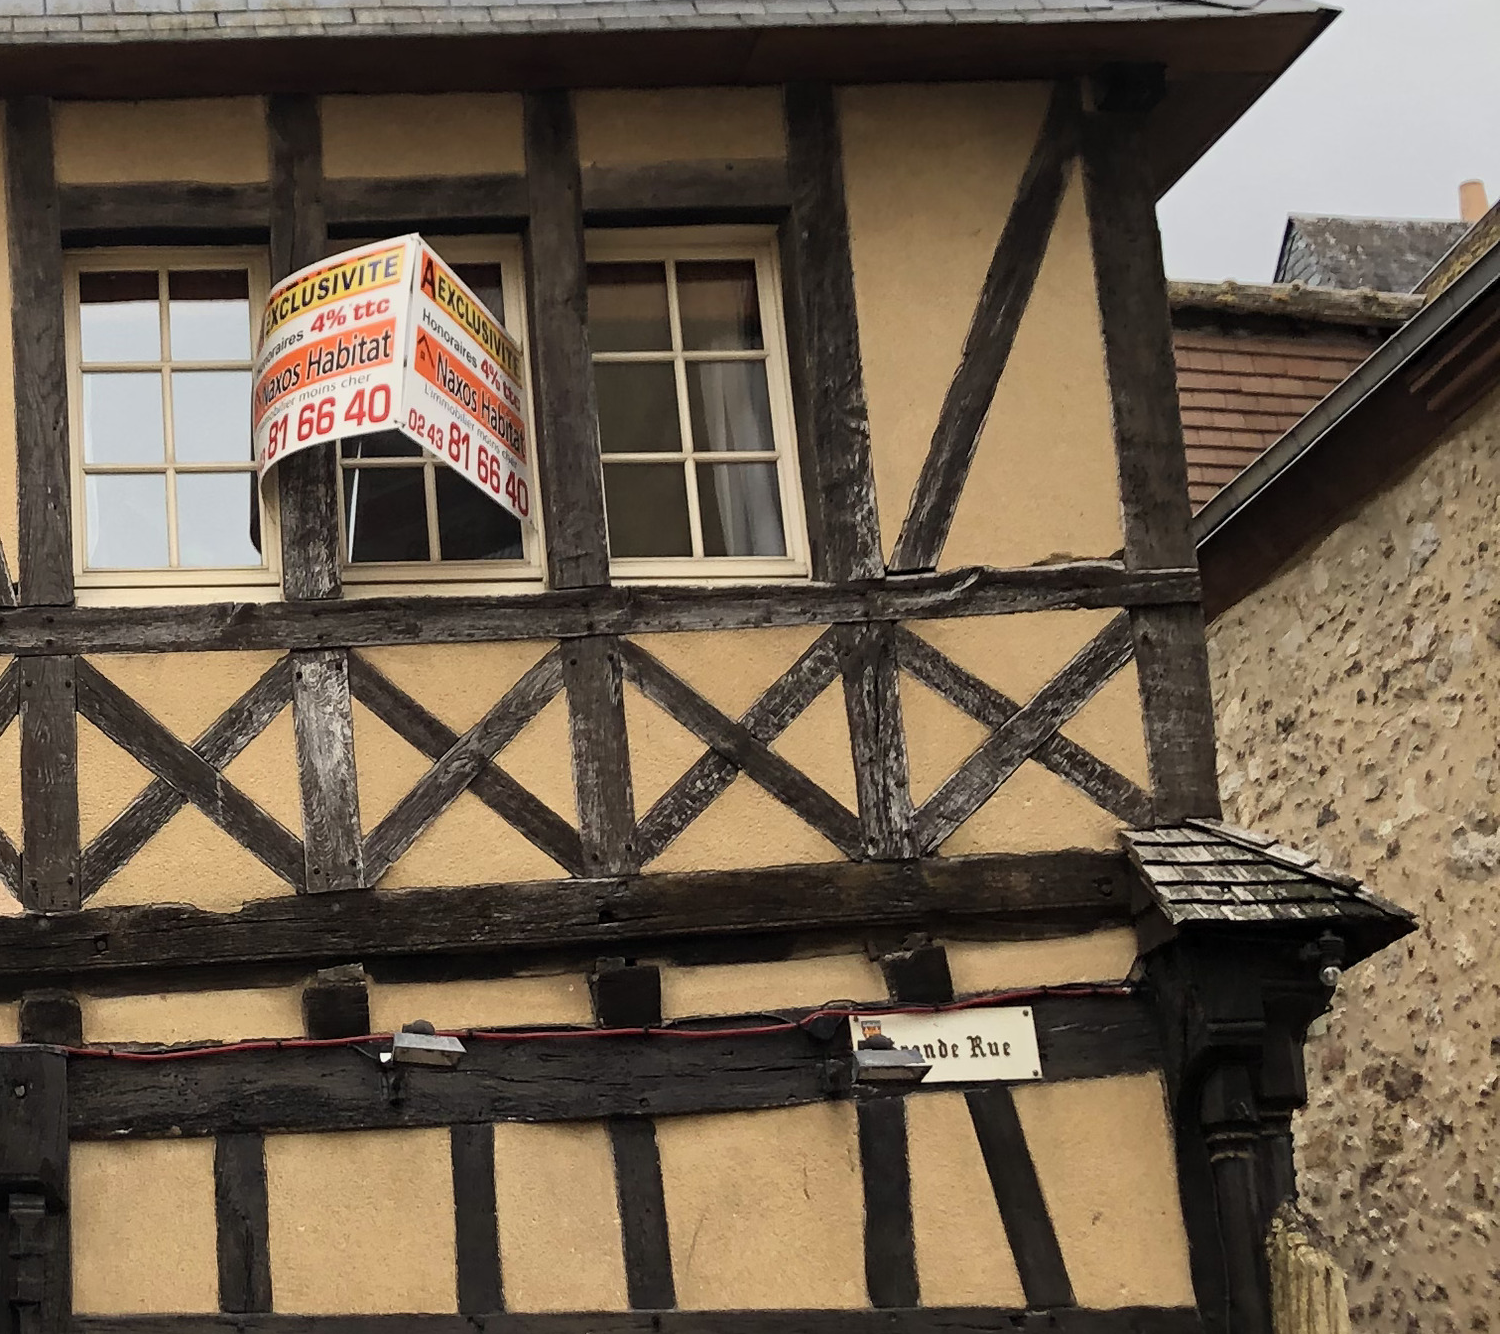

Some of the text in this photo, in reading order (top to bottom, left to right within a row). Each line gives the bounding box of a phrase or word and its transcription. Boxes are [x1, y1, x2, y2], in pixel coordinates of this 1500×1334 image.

[310, 306, 347, 333] 4%
[353, 298, 390, 321] ttc
[422, 308, 478, 369] Honoraires
[480, 358, 501, 392] 4%
[438, 275, 521, 380] EXCLUSIVITE
[298, 384, 337, 402] moins
[340, 373, 372, 389] cher
[306, 330, 392, 380] Habitat
[268, 413, 289, 460] 81
[297, 396, 336, 442] 66
[344, 383, 392, 427] 40
[436, 351, 527, 458] Naxos Habitat
[408, 408, 529, 517] 02 43 81 66 40
[899, 1035, 1011, 1059] nde Rue
